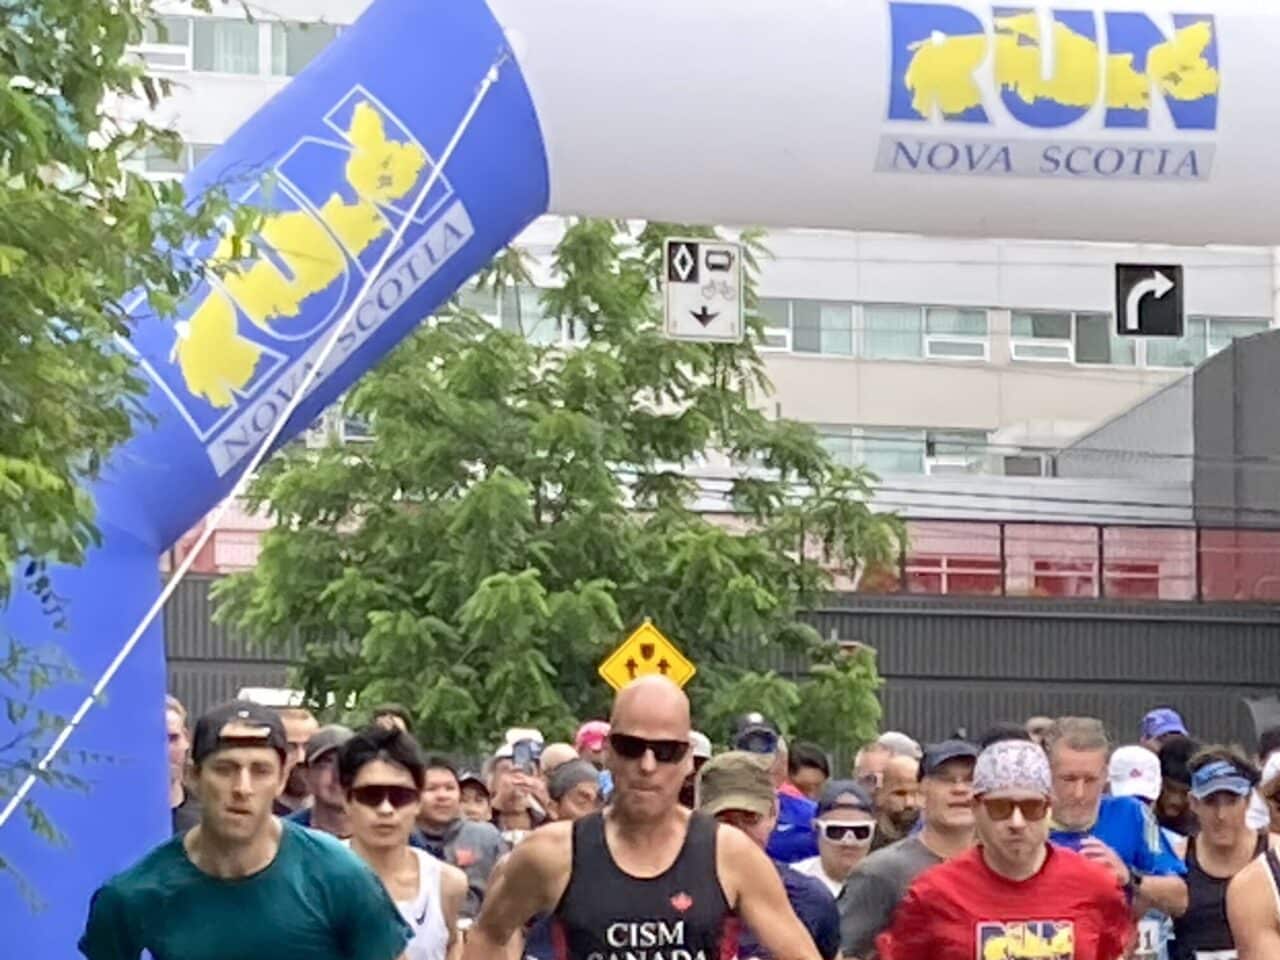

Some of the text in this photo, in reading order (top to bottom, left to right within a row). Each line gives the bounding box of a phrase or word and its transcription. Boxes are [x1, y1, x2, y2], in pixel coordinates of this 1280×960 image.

[888, 2, 1219, 130] RUN
[892, 140, 1200, 176] NOVA SCOTIA
[336, 220, 466, 352] SCOTIA
[606, 920, 685, 948] CISM
